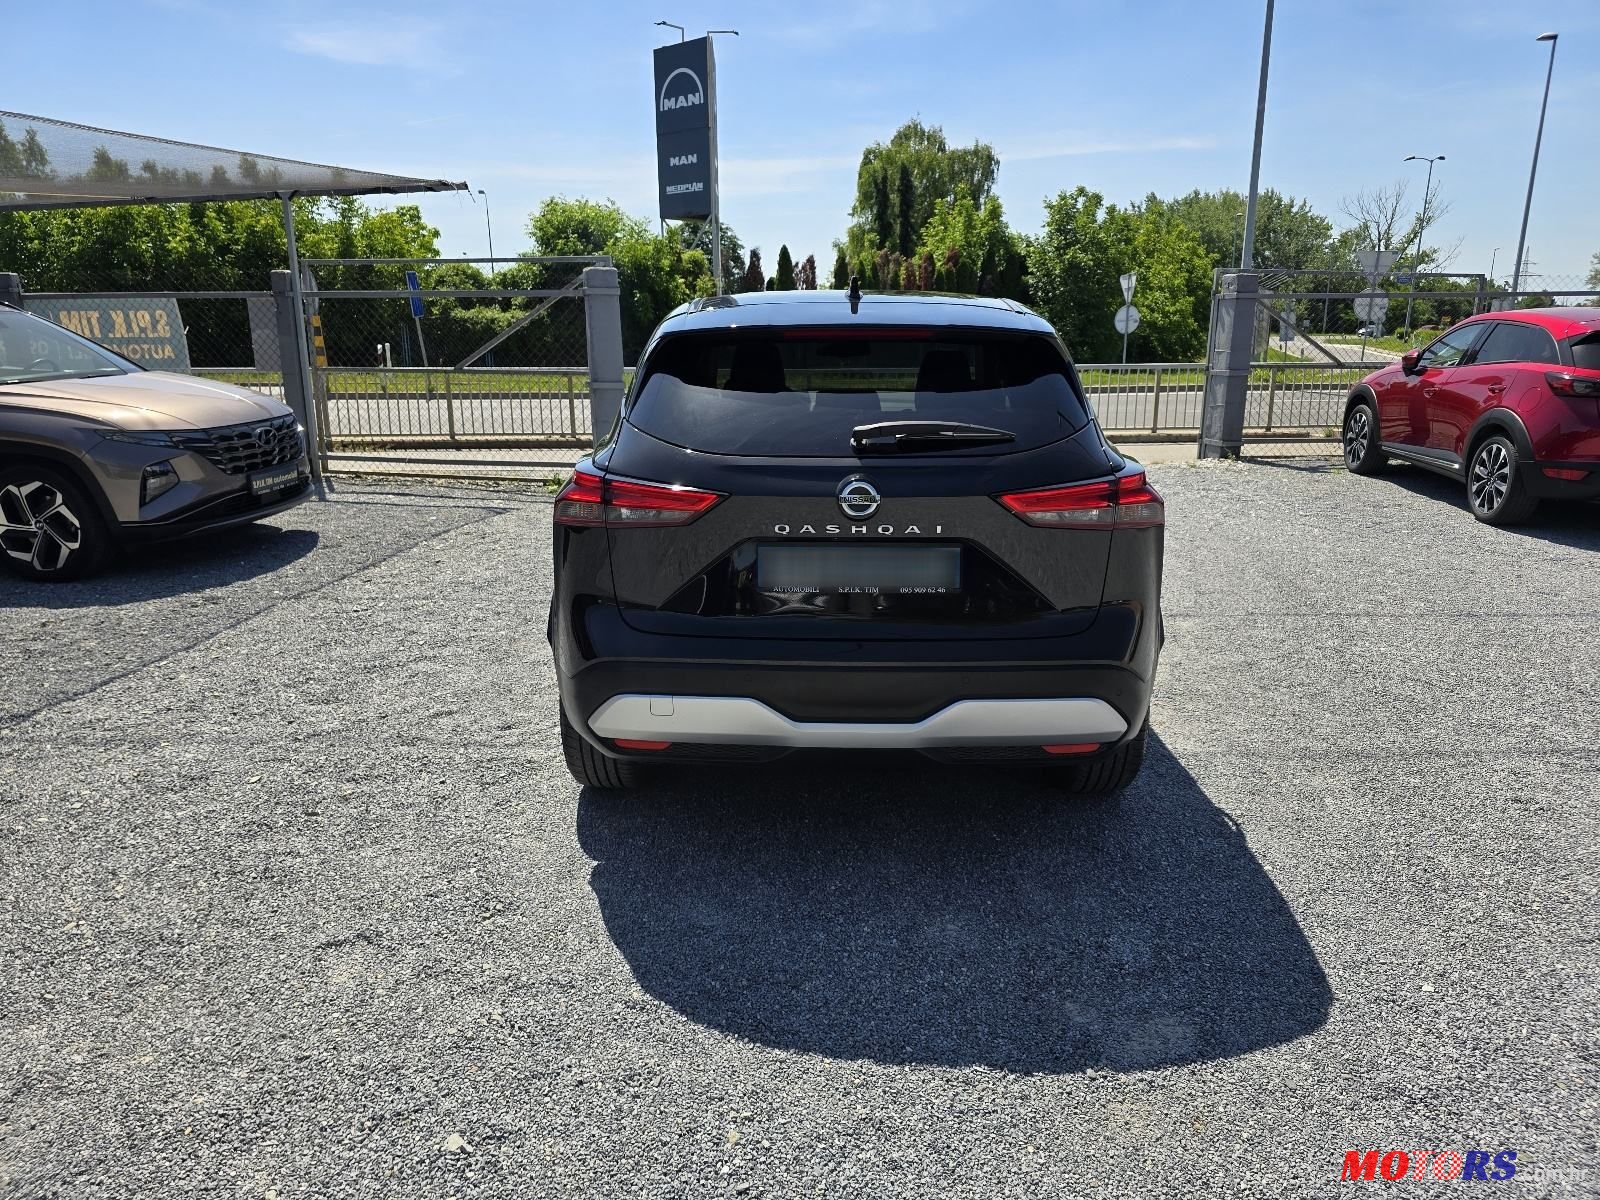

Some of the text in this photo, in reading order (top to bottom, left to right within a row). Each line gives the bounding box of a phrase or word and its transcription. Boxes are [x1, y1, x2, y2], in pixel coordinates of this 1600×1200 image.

[663, 92, 700, 111] MAN
[669, 153, 698, 167] MAN
[666, 182, 704, 194] NEOPLAN
[842, 495, 878, 504] NISSAN
[773, 524, 943, 536] QASHQAI
[900, 586, 913, 594] 095
[913, 586, 927, 594] 909
